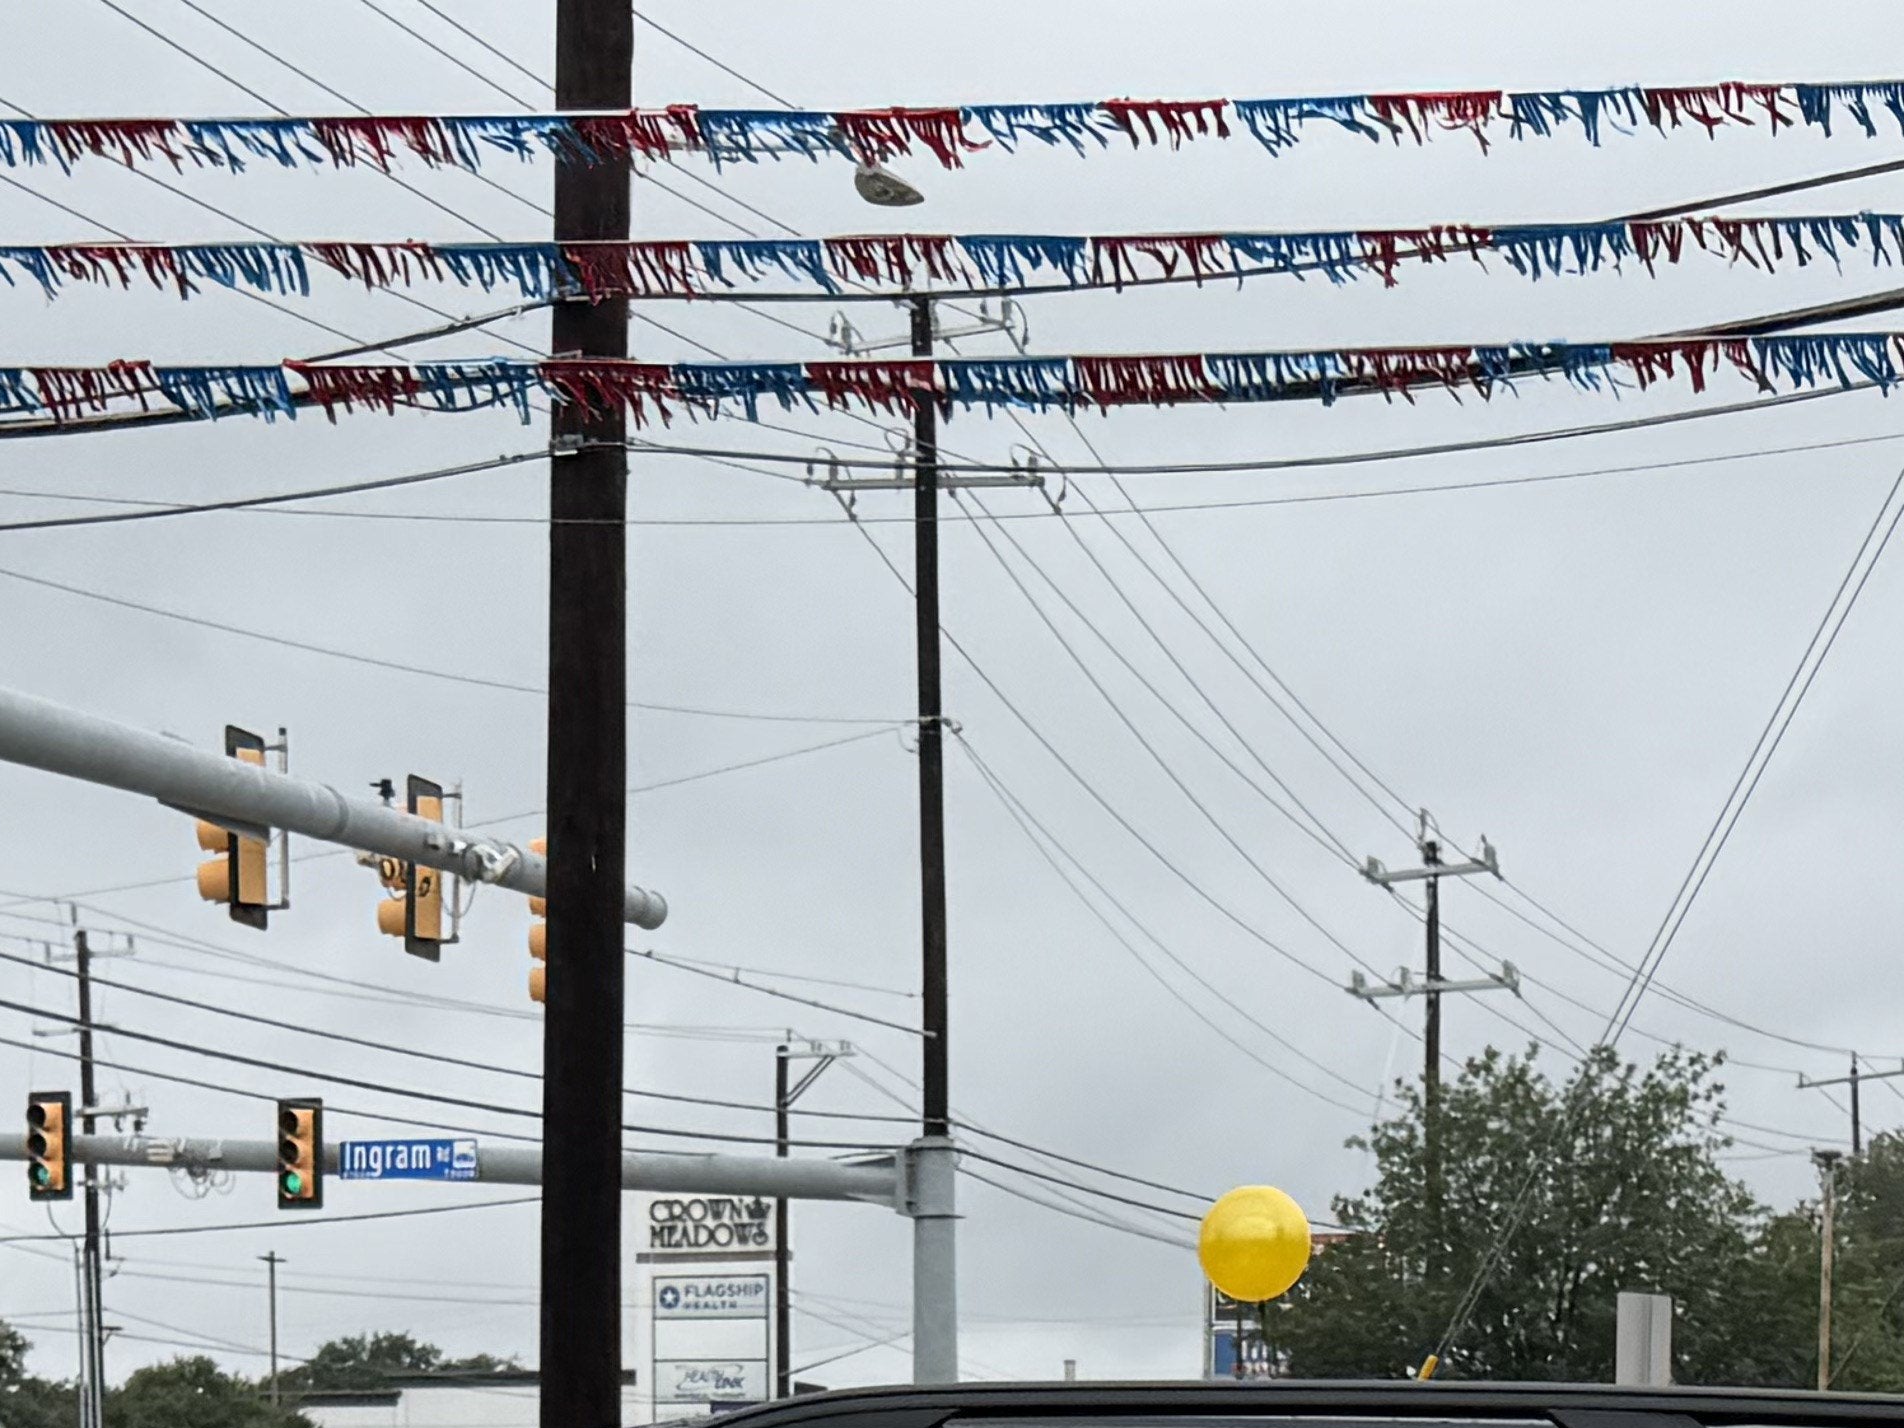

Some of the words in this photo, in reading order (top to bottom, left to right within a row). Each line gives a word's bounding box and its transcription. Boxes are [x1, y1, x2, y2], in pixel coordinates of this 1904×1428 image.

[345, 1143, 431, 1178] Ingram
[649, 1198, 744, 1223] CROWN
[650, 1222, 769, 1248] MEADOWS
[683, 1283, 764, 1298] FLAGSHIP
[683, 1300, 738, 1310] HEALTH
